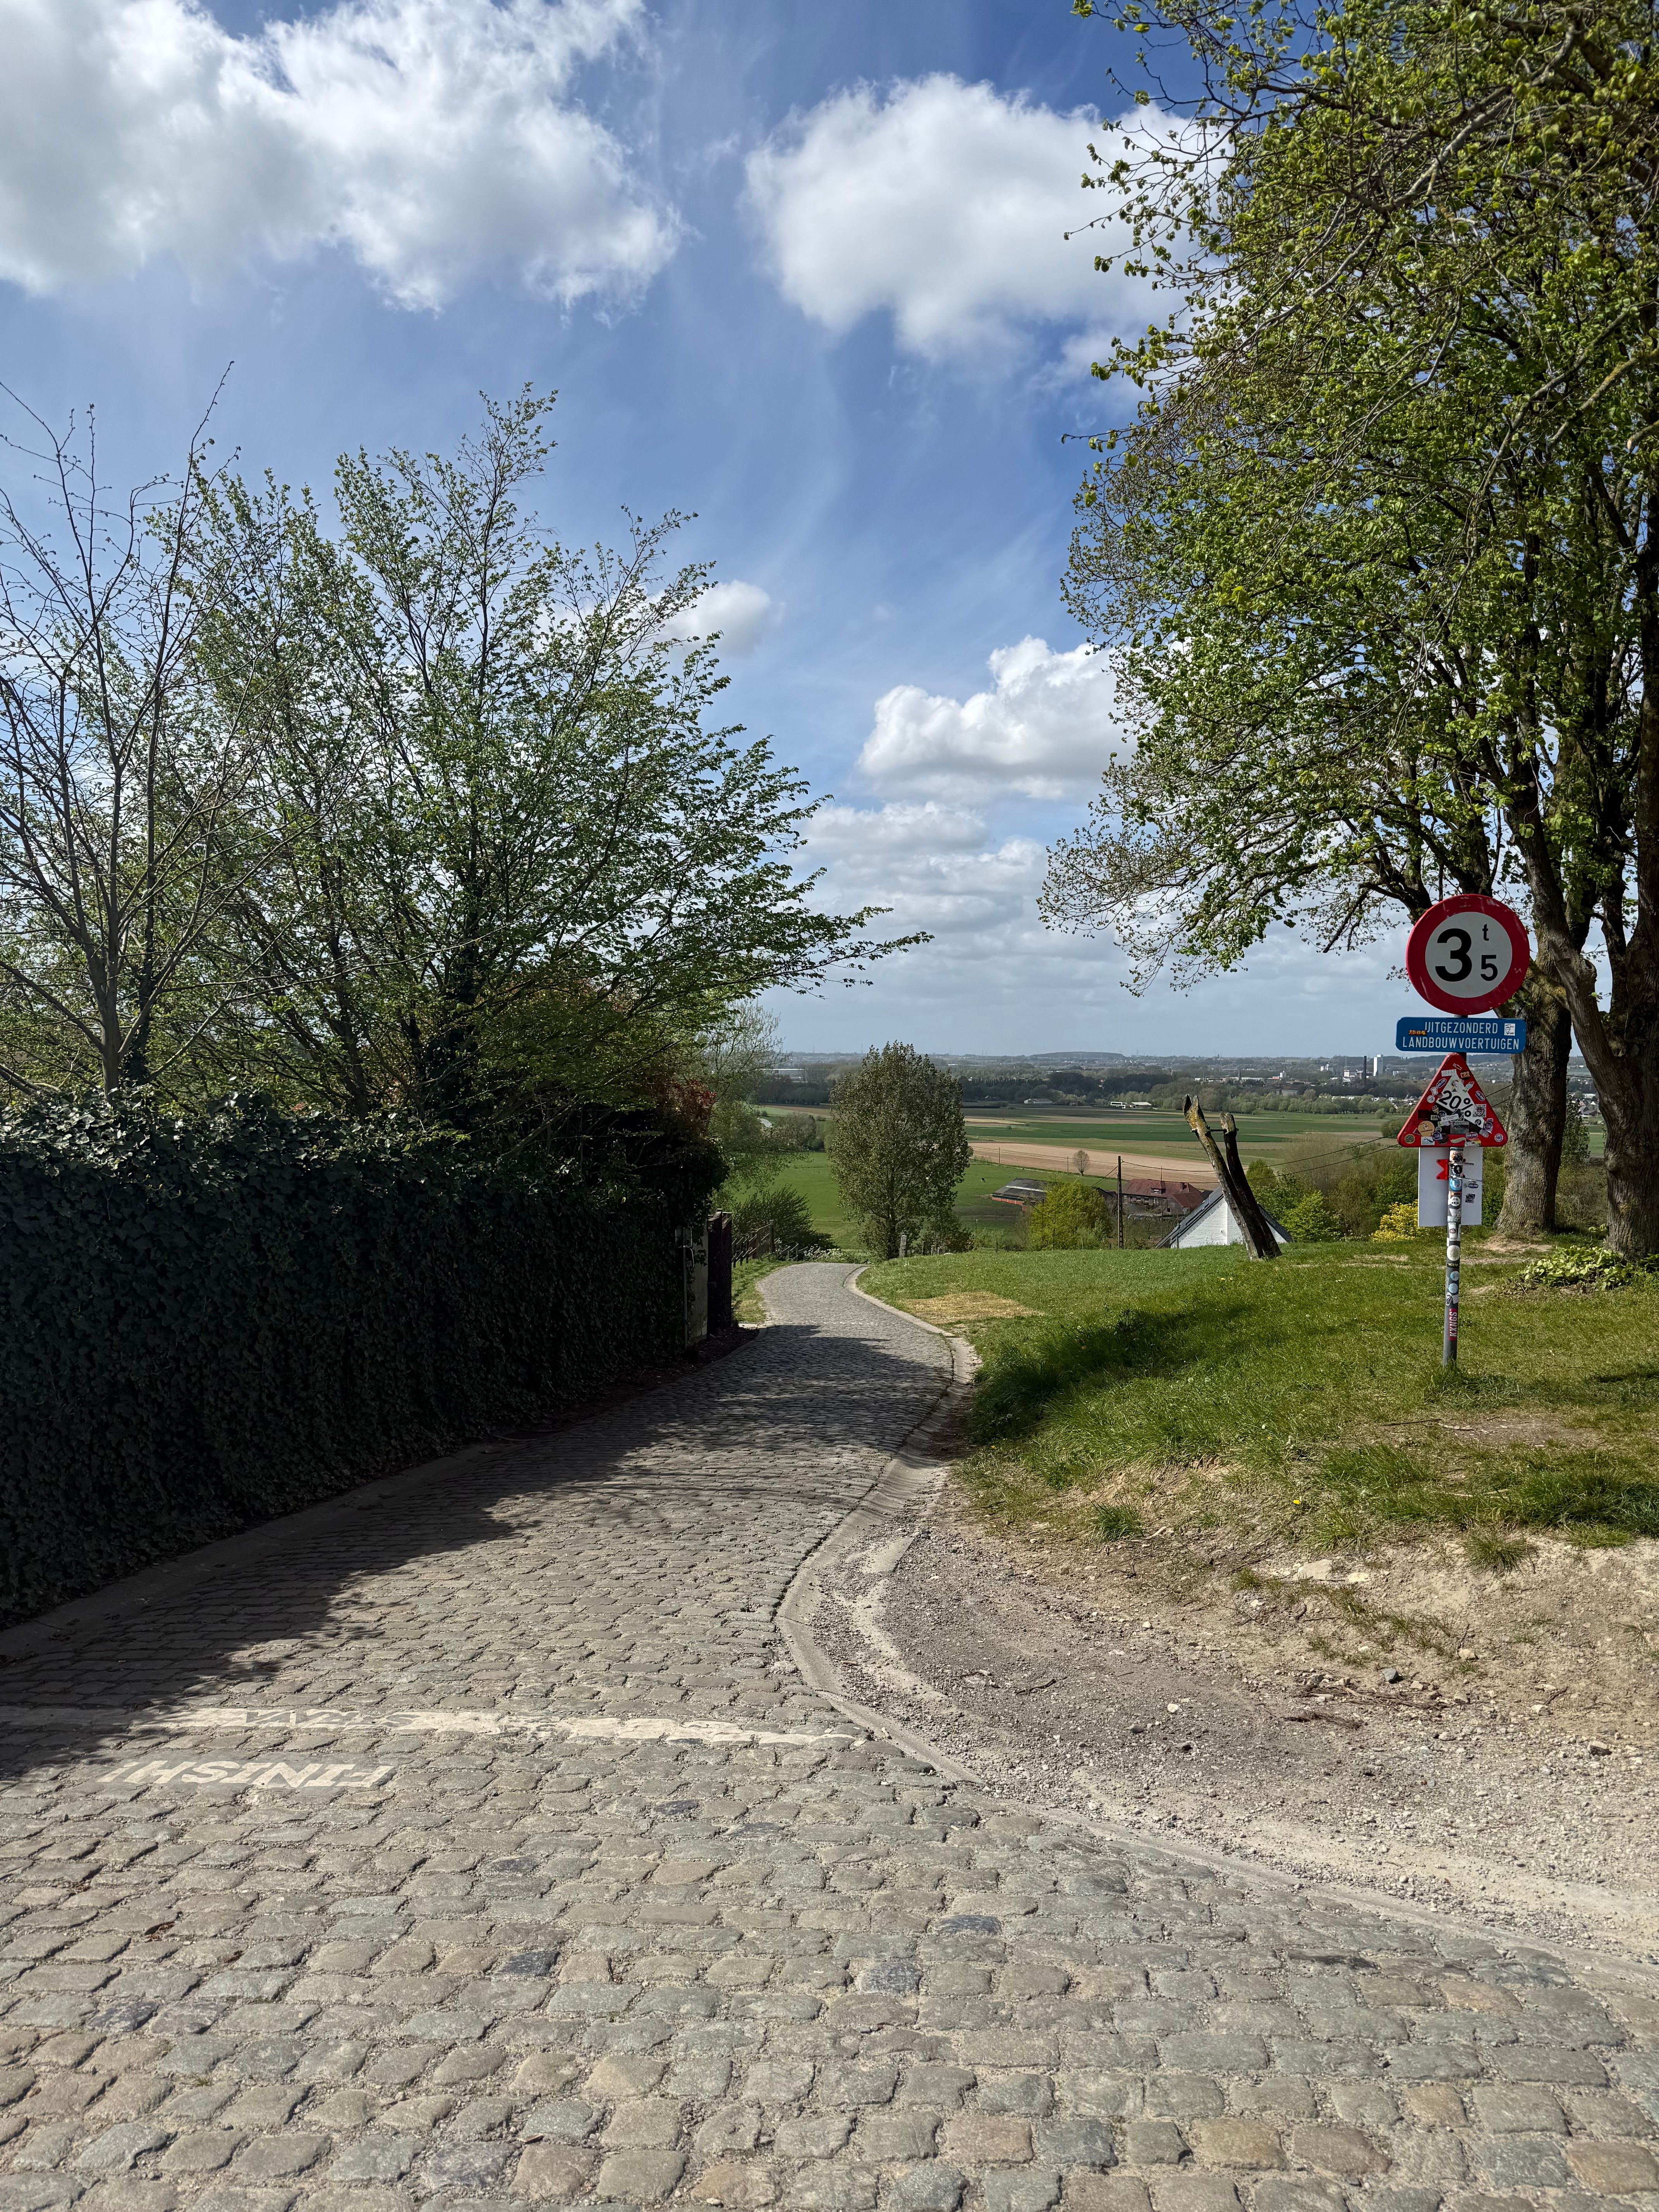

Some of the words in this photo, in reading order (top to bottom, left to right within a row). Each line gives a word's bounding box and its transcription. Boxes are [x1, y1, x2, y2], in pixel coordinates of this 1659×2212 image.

[1482, 924, 1489, 941] t
[1435, 928, 1472, 982] 3
[1480, 955, 1498, 981] 5
[1424, 1022, 1498, 1034] UITGEZONDERD
[1403, 1037, 1519, 1050] LANDBOUWVOERTUIGEN
[1439, 1090, 1474, 1118] 20%
[97, 1760, 394, 1788] FINISH!
